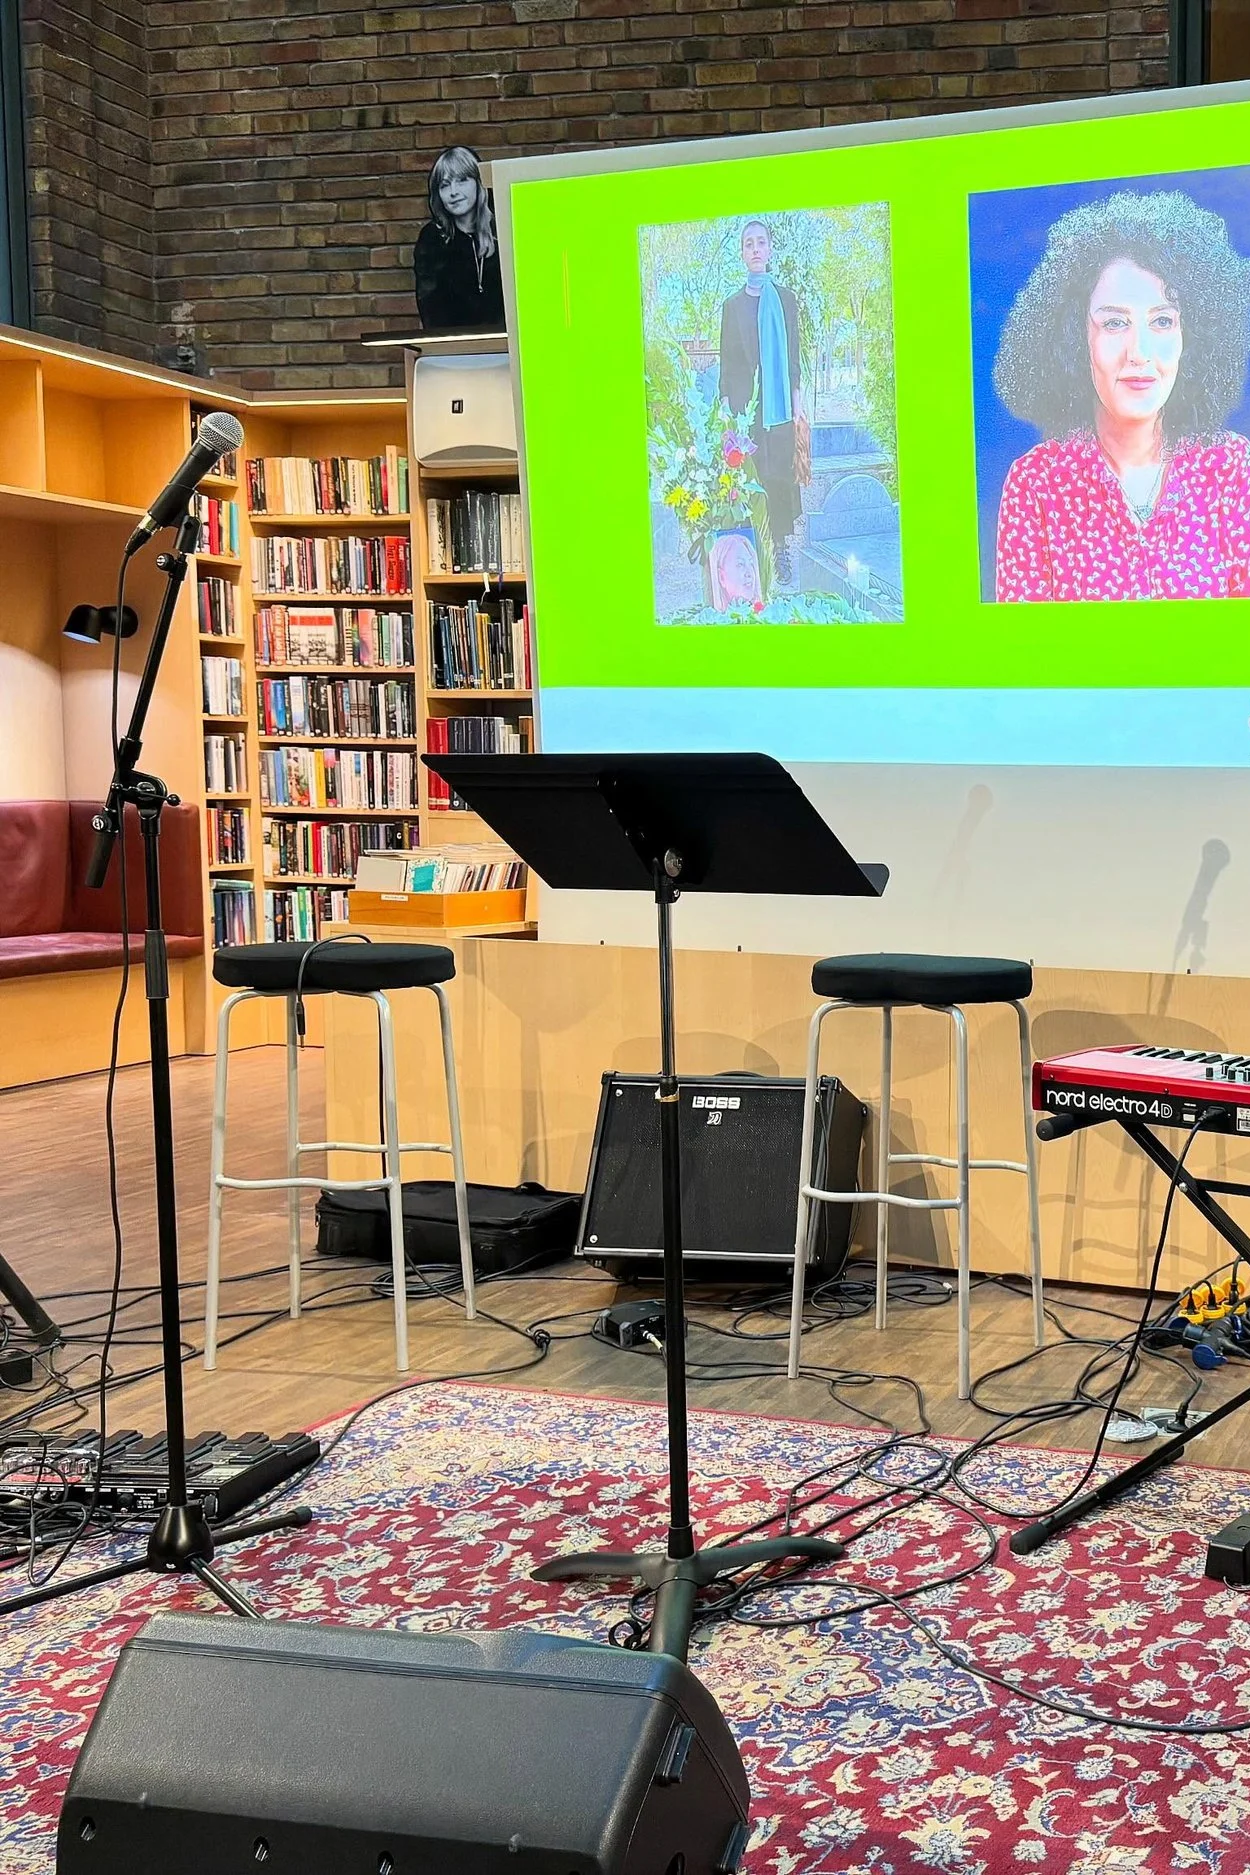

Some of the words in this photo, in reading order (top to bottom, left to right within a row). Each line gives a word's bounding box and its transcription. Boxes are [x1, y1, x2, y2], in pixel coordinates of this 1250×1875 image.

[691, 1095, 741, 1110] BOSS
[1046, 1089, 1086, 1109] nord
[1088, 1093, 1148, 1116] electro
